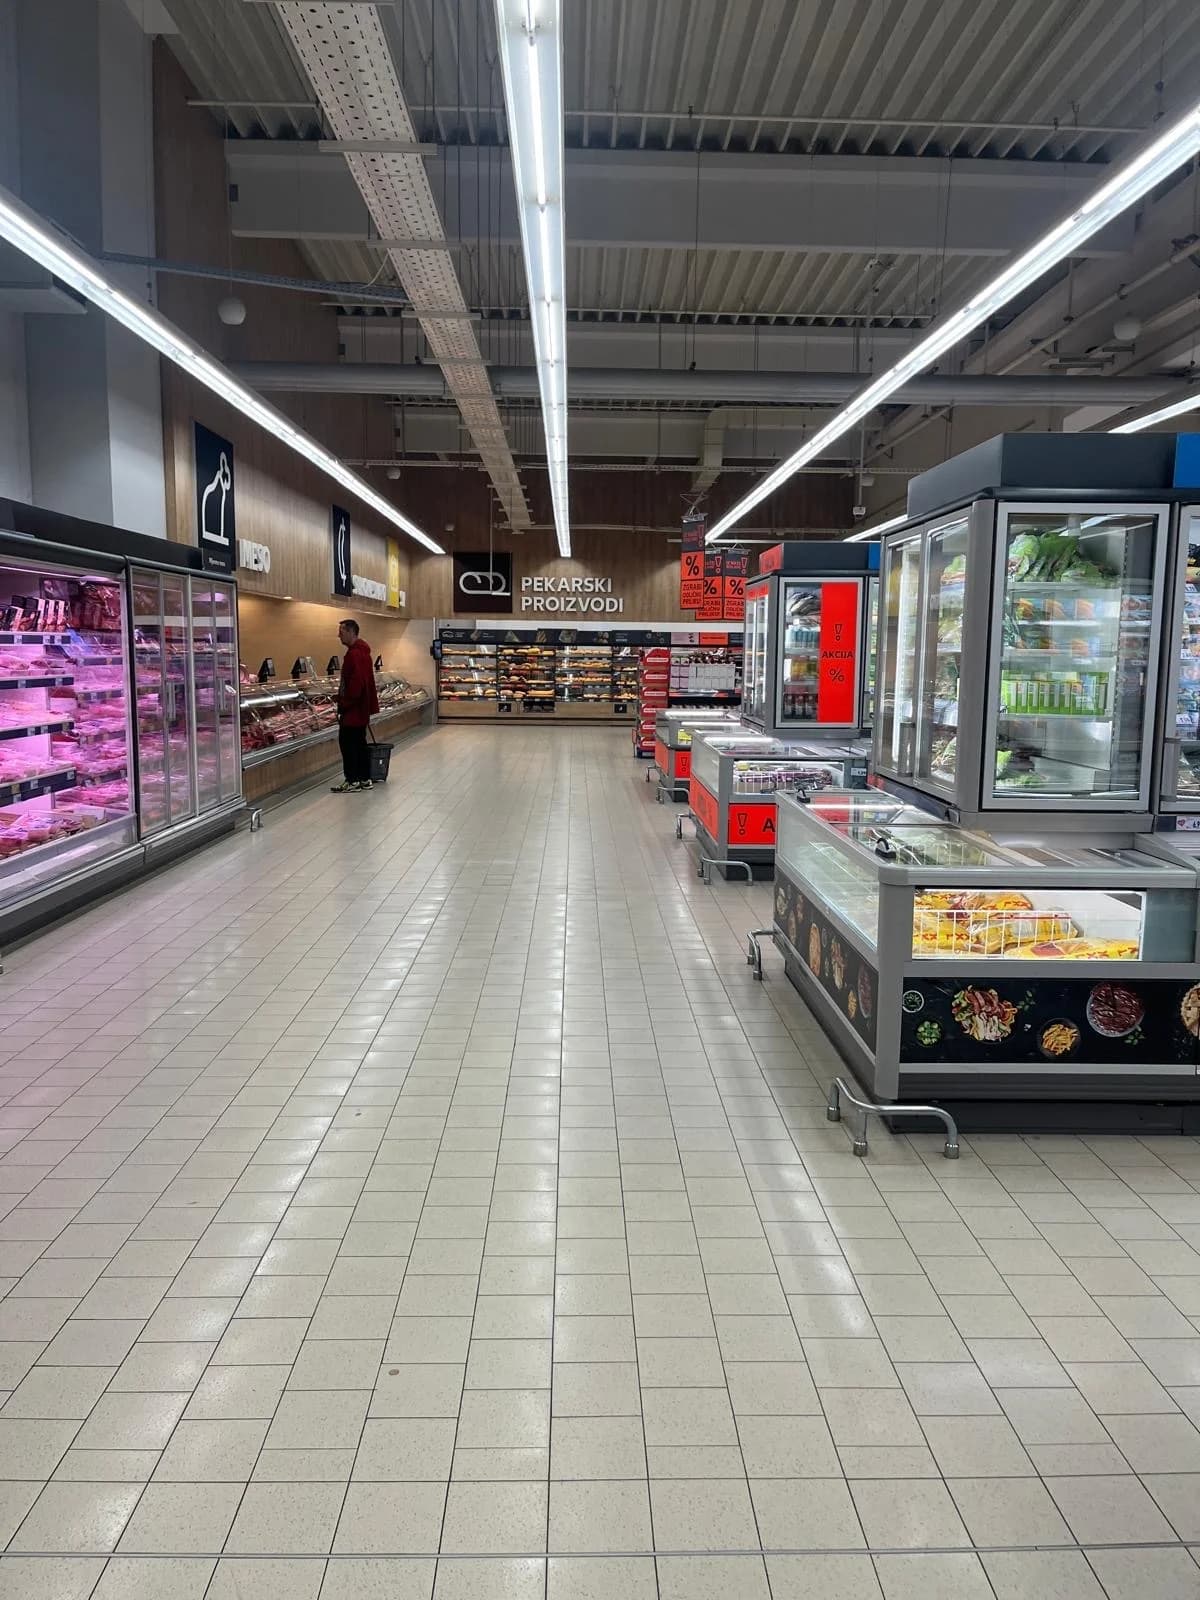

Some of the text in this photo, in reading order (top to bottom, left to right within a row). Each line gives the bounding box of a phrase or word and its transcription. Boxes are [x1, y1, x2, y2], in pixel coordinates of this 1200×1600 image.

[521, 577, 612, 592] PEKARSKI
[521, 597, 624, 612] PROIZVODI
[822, 651, 853, 659] AKCIJA
